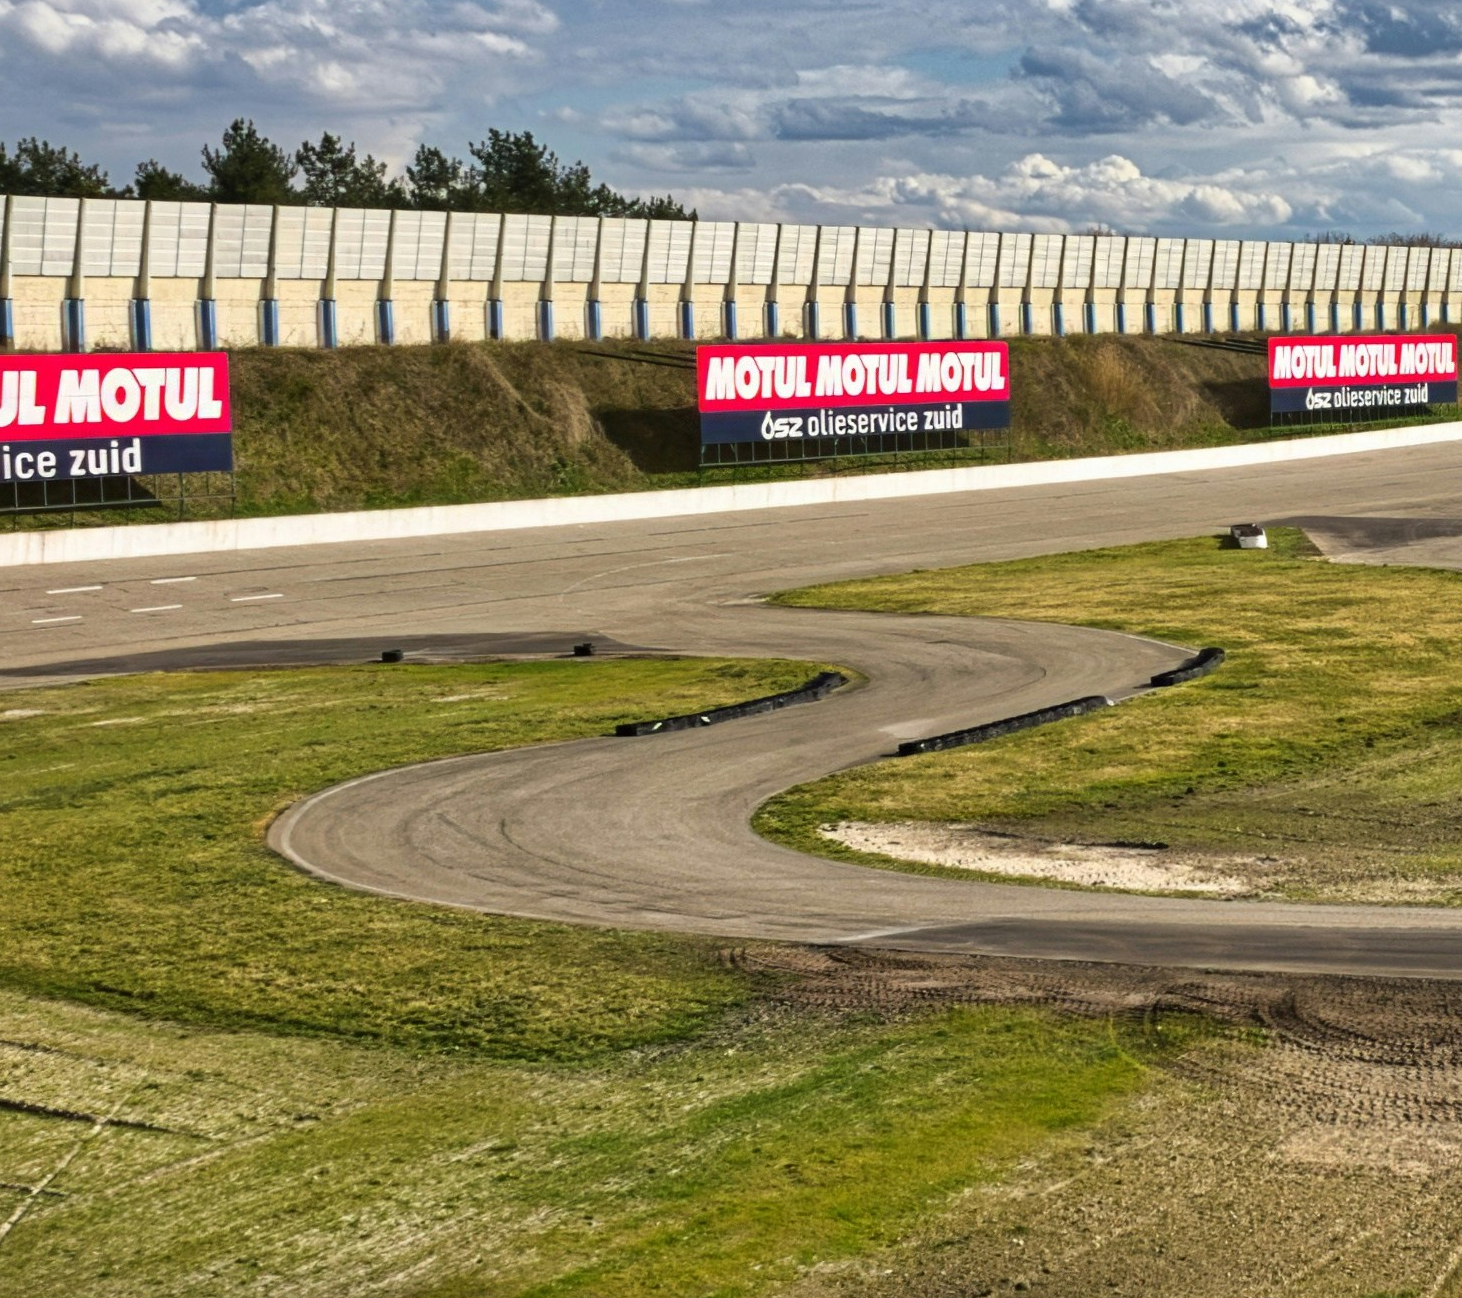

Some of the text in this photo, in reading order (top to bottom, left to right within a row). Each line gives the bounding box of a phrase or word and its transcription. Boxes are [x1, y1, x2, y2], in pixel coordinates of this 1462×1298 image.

[705, 352, 1005, 401] MOTUL MOTUL MOTUL
[1274, 343, 1455, 379] MOTUL MOTUL MOTUL
[54, 367, 222, 423] MOTUL
[1333, 385, 1401, 407] olieservice
[1404, 383, 1429, 404] zuid
[808, 408, 918, 437] olieservice
[923, 403, 963, 430] zuid
[69, 438, 142, 476] zuid
